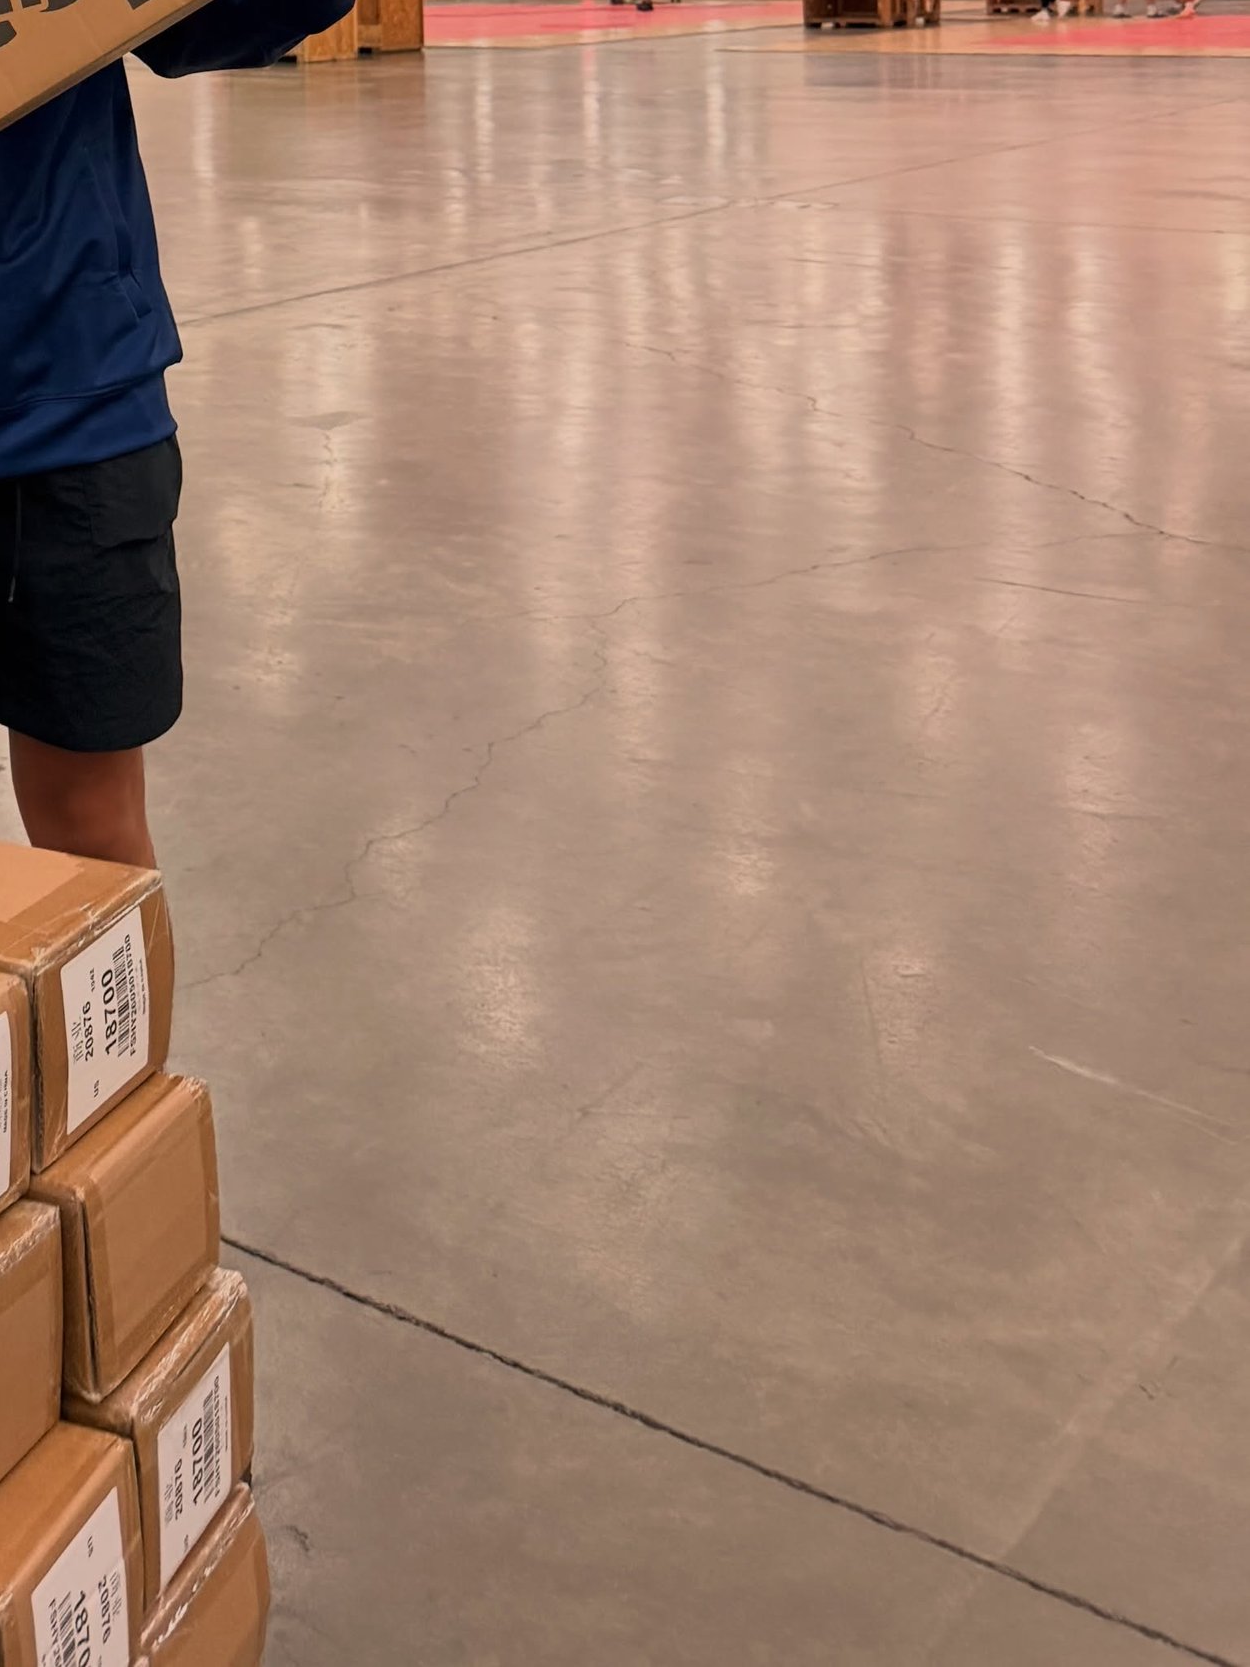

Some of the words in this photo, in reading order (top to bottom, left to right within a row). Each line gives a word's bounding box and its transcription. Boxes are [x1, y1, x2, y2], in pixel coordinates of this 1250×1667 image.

[82, 1001, 94, 1061] 20876
[101, 969, 117, 1054] 18700
[94, 1080, 100, 1097] US
[174, 1459, 183, 1520] 20876
[192, 1418, 203, 1505] 18700
[98, 1576, 111, 1645] 20876
